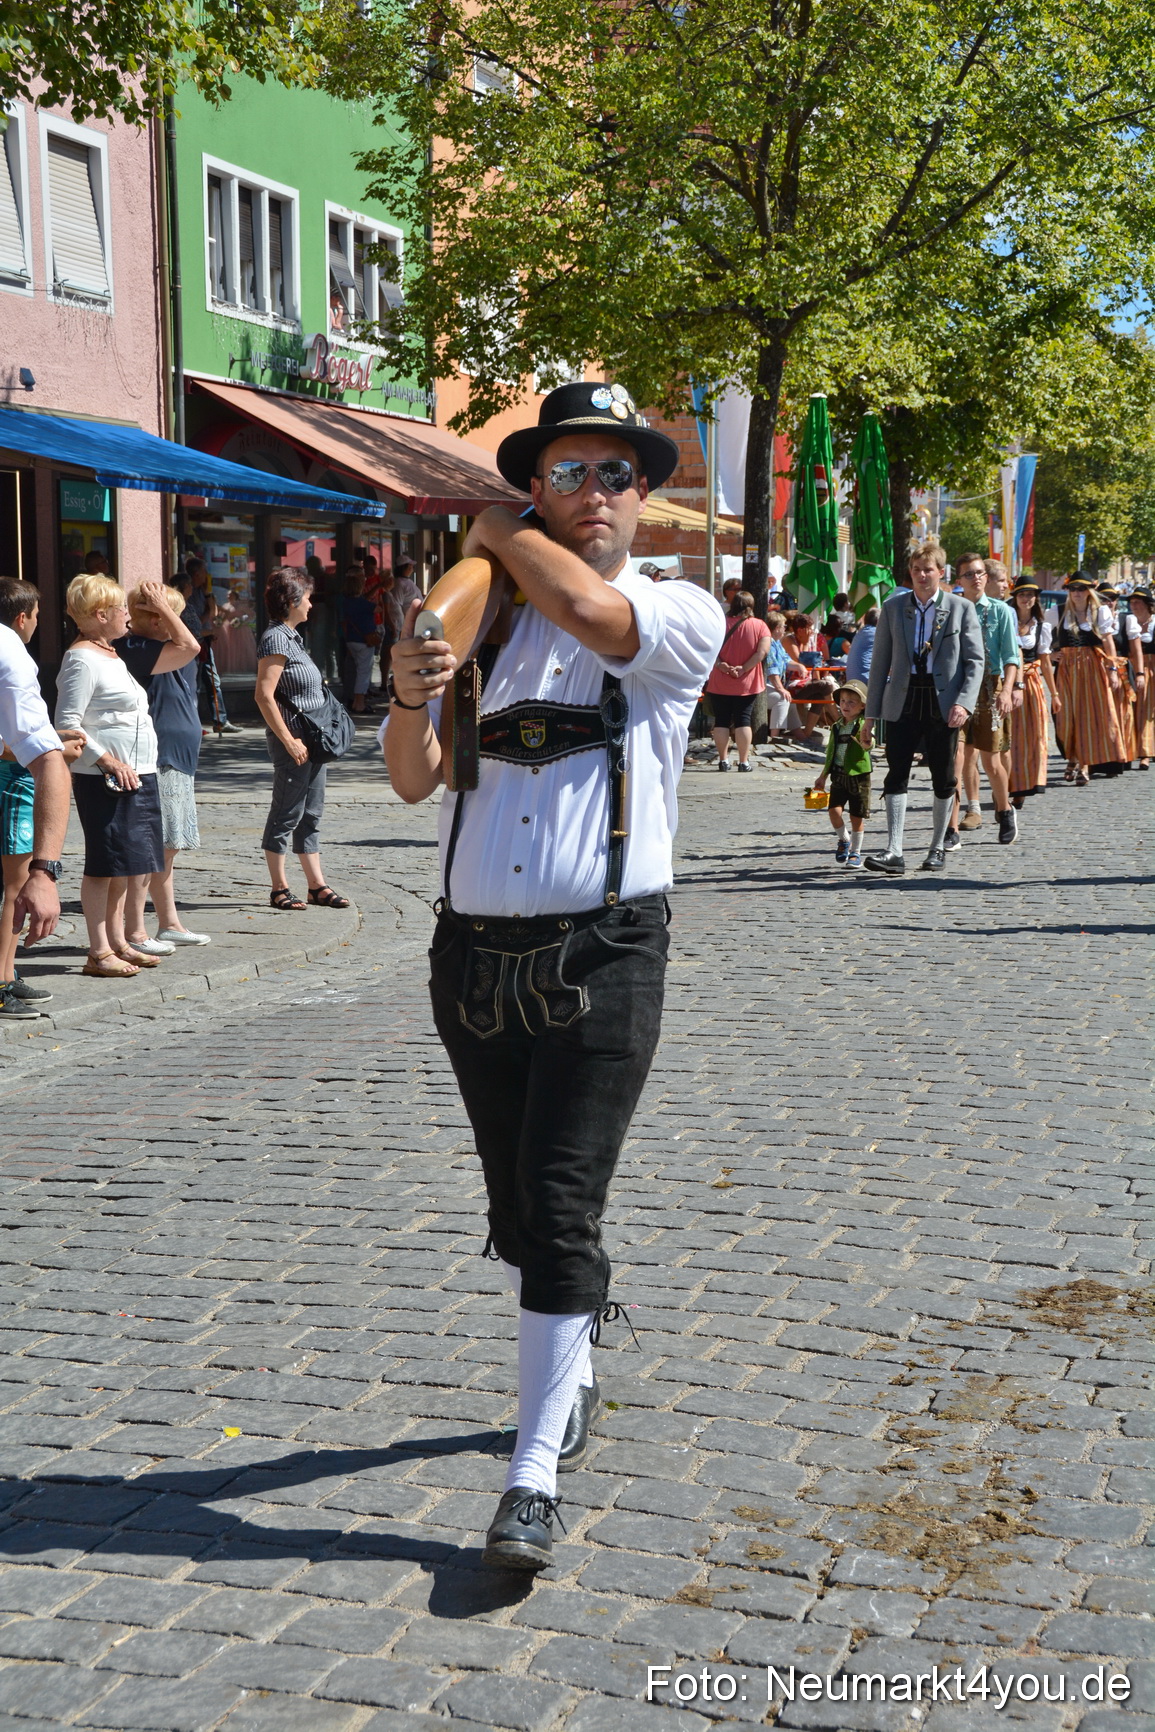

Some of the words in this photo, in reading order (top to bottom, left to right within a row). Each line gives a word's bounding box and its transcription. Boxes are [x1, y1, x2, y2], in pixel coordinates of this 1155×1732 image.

[251, 350, 299, 376] METZGEREI
[303, 333, 375, 393] Bögerl
[63, 490, 87, 513] Essig
[92, 490, 103, 510] Öl
